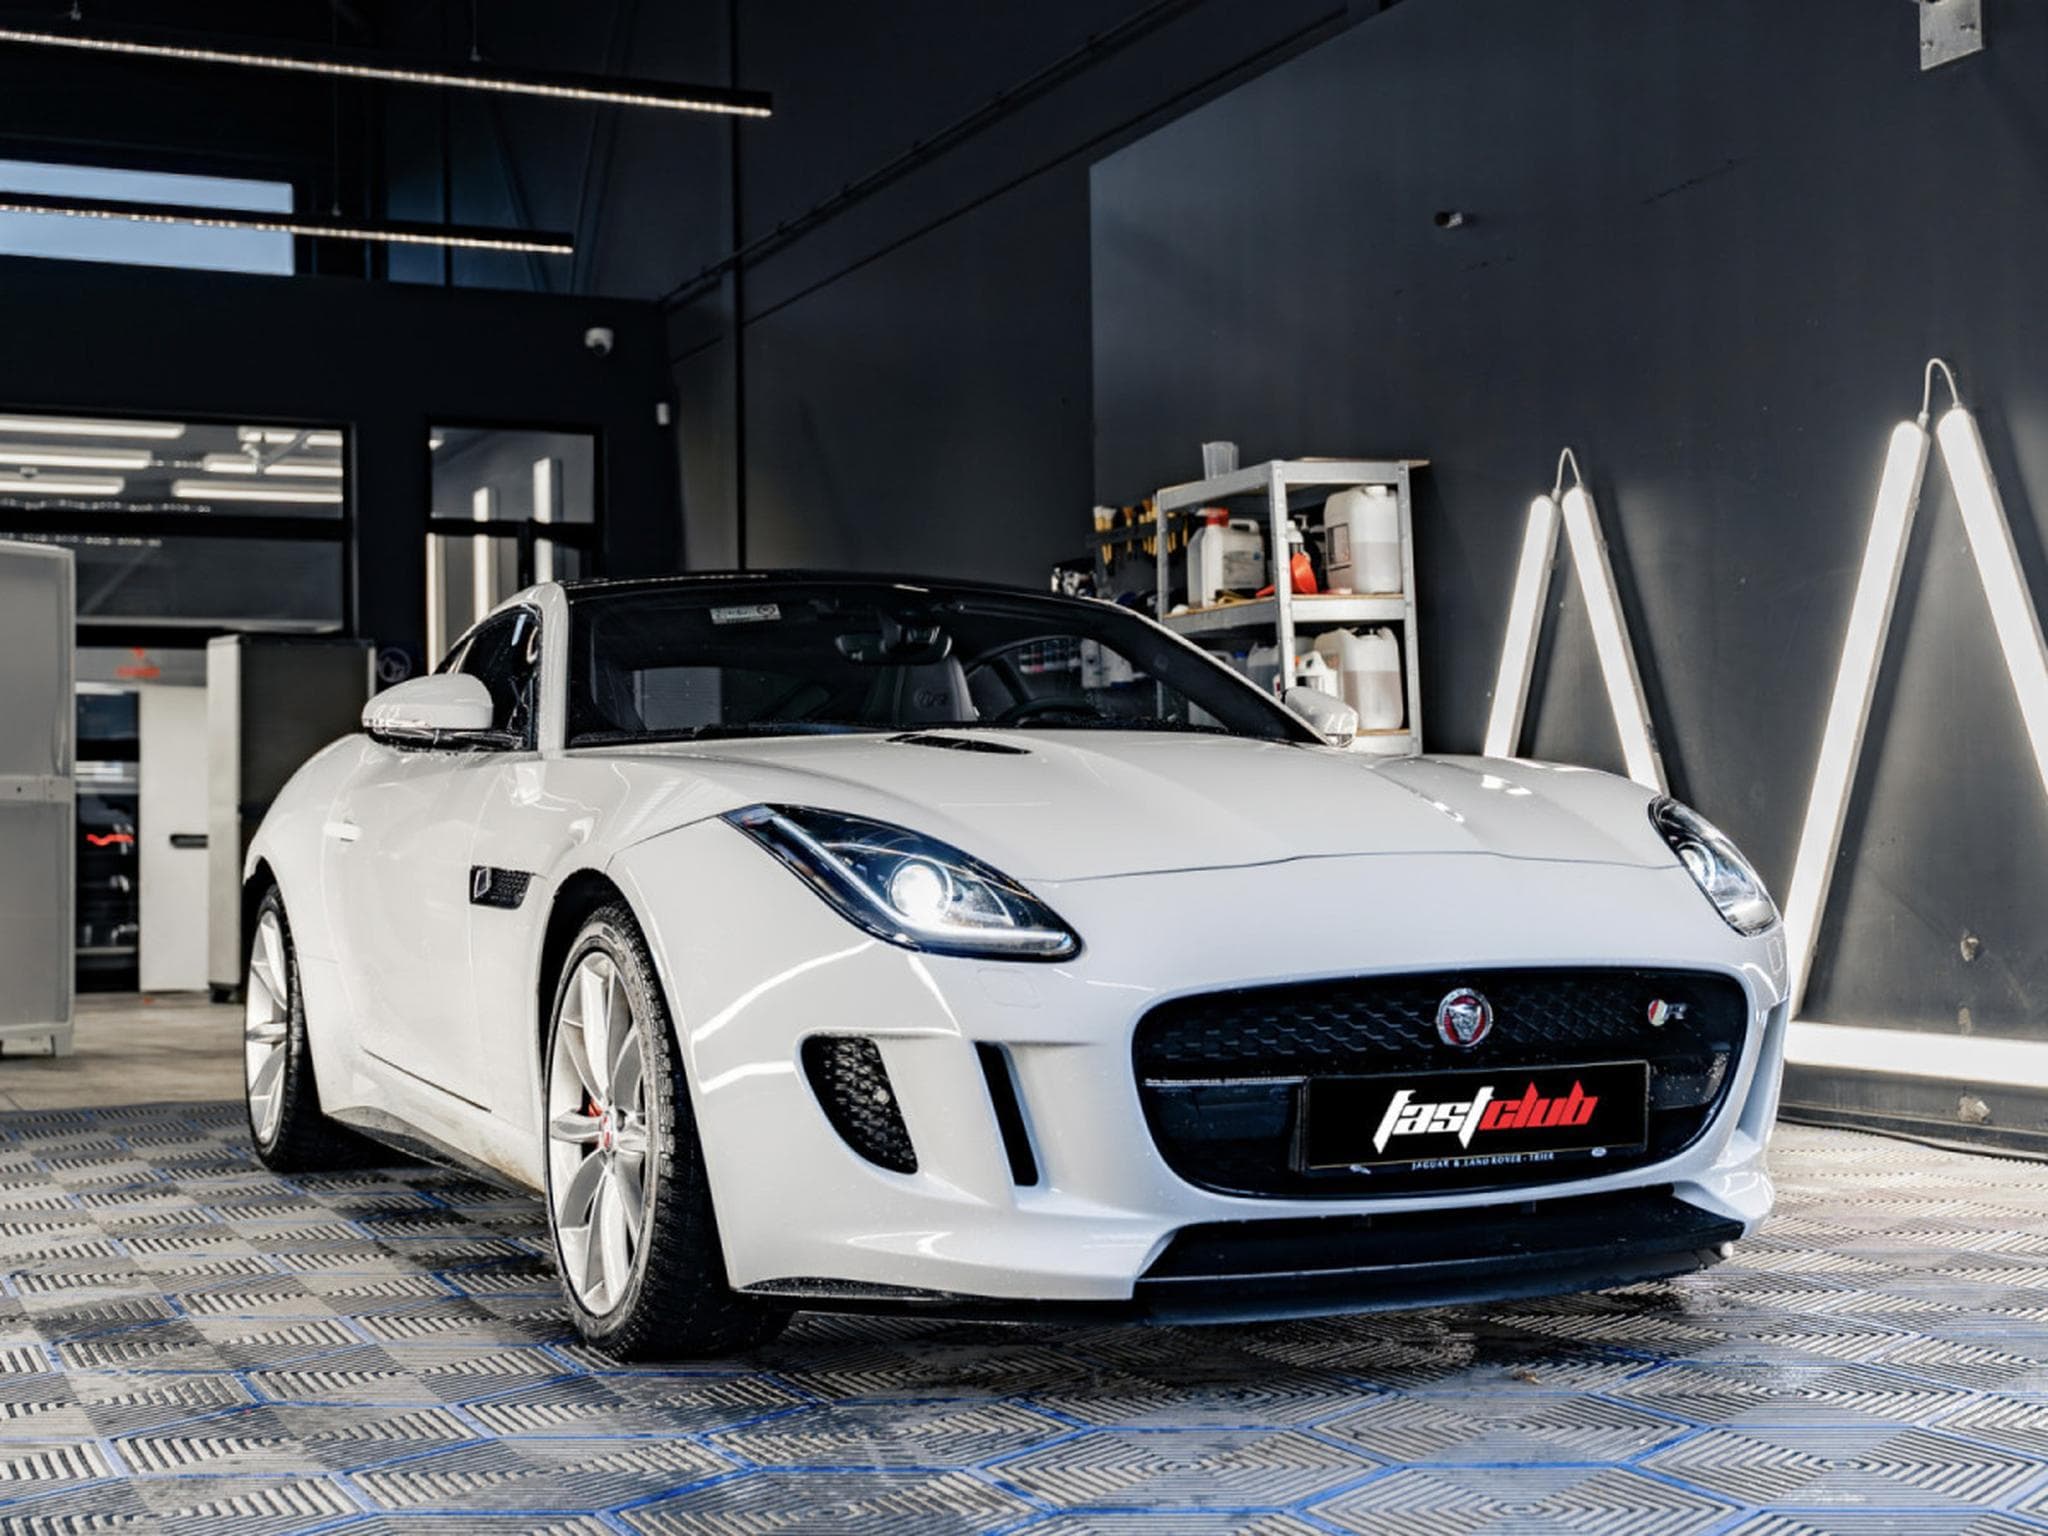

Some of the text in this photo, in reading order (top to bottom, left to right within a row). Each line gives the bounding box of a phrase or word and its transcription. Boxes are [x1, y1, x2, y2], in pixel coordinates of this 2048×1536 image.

[1412, 1160, 1449, 1172] JAGUAR
[1464, 1158, 1489, 1168] LAND
[1491, 1154, 1522, 1166] ROVER
